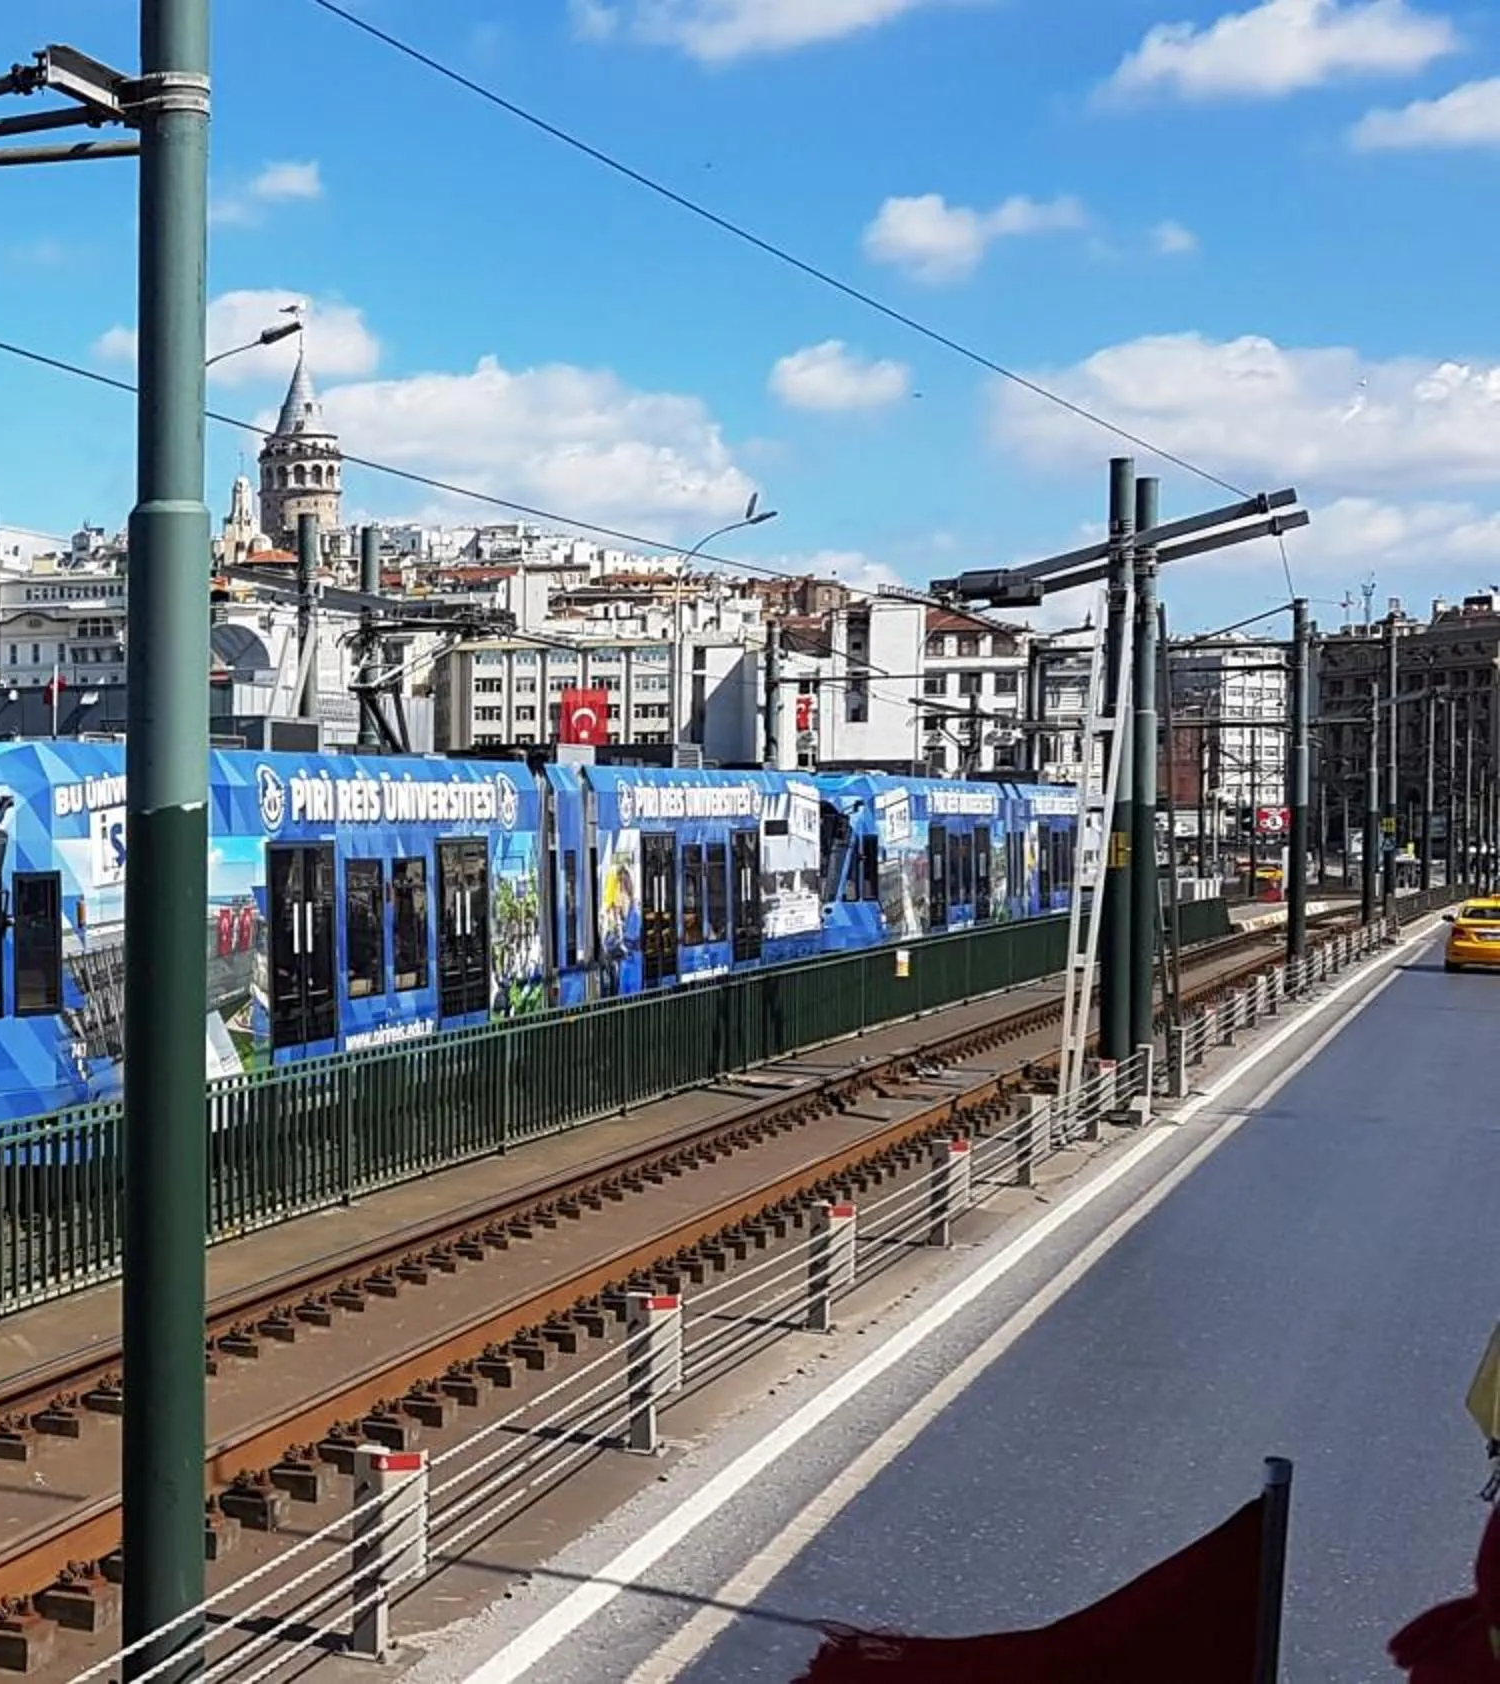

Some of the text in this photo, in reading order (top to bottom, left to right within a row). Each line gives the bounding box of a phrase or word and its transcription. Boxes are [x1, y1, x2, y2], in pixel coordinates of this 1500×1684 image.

[55, 784, 83, 816] BU
[290, 769, 499, 822] PİRİ REİS ÜNİVERSİTESİ
